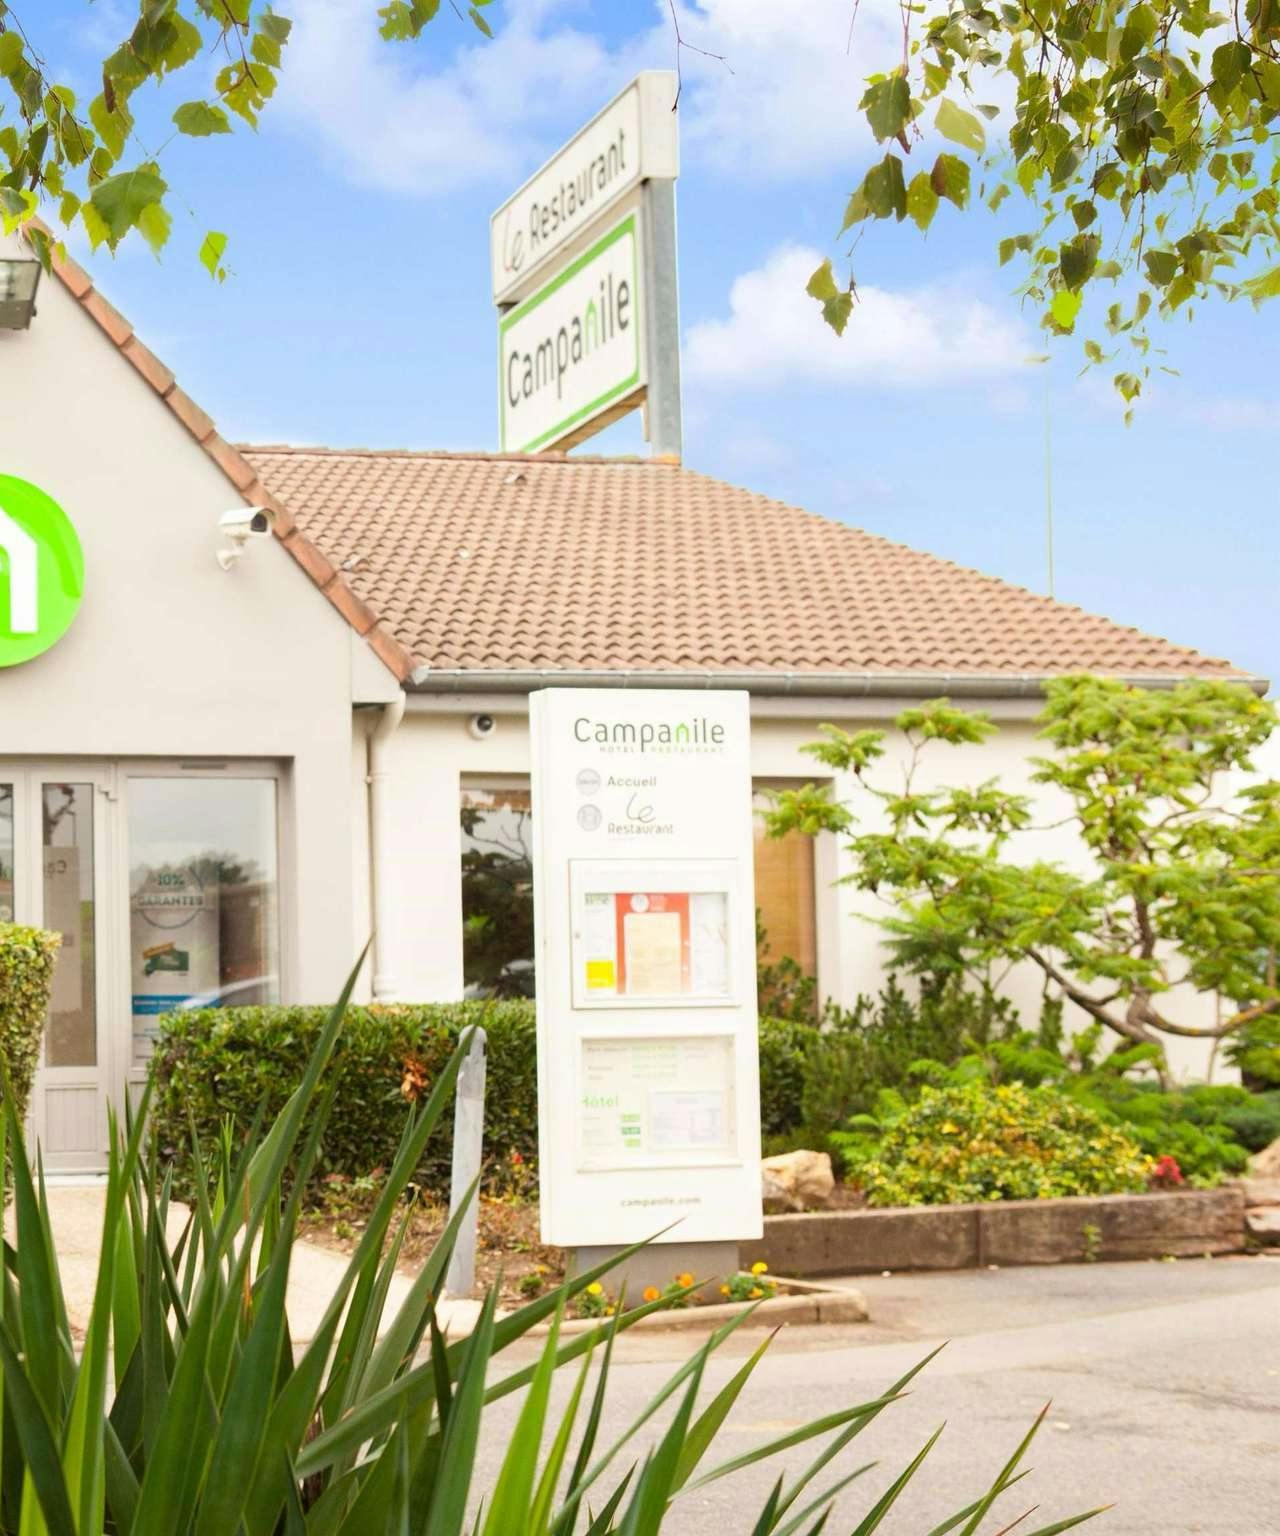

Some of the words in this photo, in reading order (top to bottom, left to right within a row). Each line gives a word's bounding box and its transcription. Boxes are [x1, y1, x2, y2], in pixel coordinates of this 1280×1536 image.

[530, 128, 627, 250] Restaurant
[507, 273, 630, 408] Campanile
[574, 717, 725, 752] Campanile
[607, 776, 657, 787] Accueil
[607, 822, 673, 835] Restaurant
